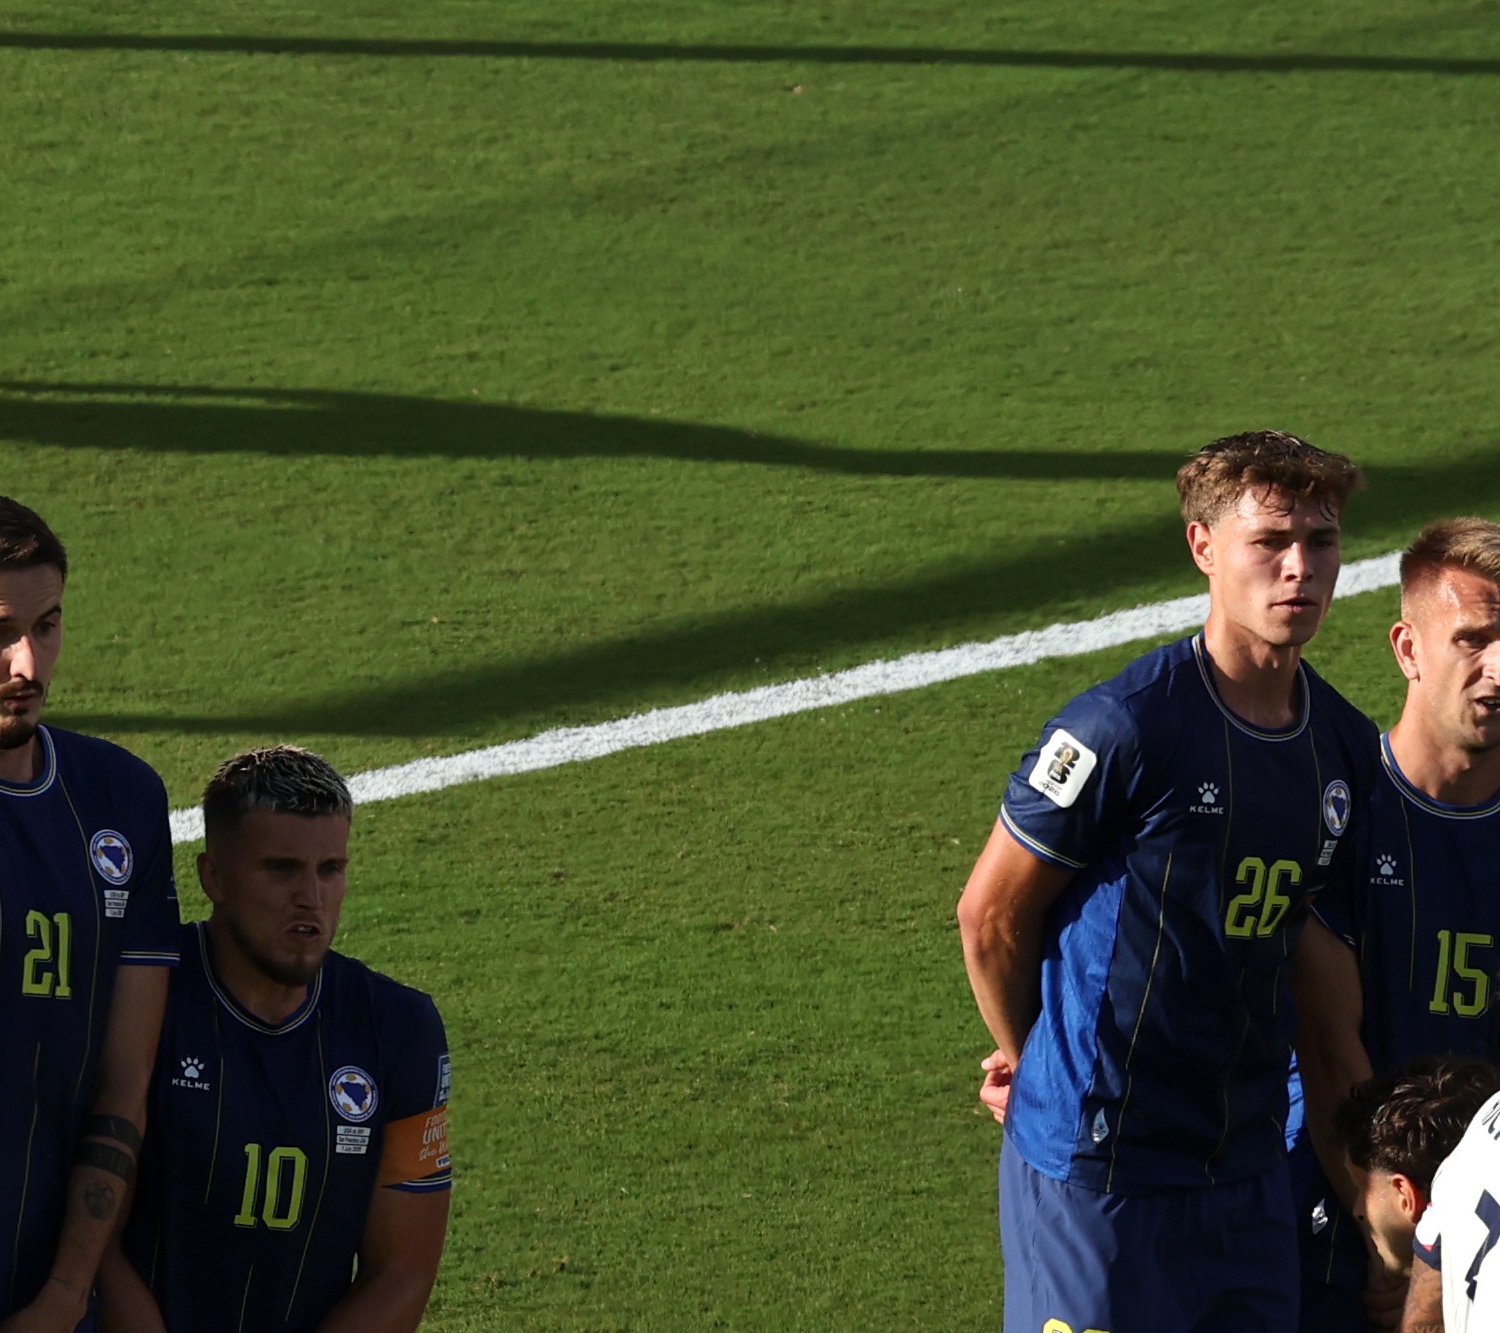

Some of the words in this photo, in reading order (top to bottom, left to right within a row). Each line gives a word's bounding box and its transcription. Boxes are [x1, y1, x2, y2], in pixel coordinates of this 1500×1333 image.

[1189, 805, 1224, 815] KELME
[1224, 857, 1302, 938] 26
[1370, 877, 1404, 886] KELME
[21, 909, 72, 999] 21
[1429, 930, 1493, 1018] 15
[172, 1078, 211, 1090] KELME
[234, 1143, 308, 1231] 10
